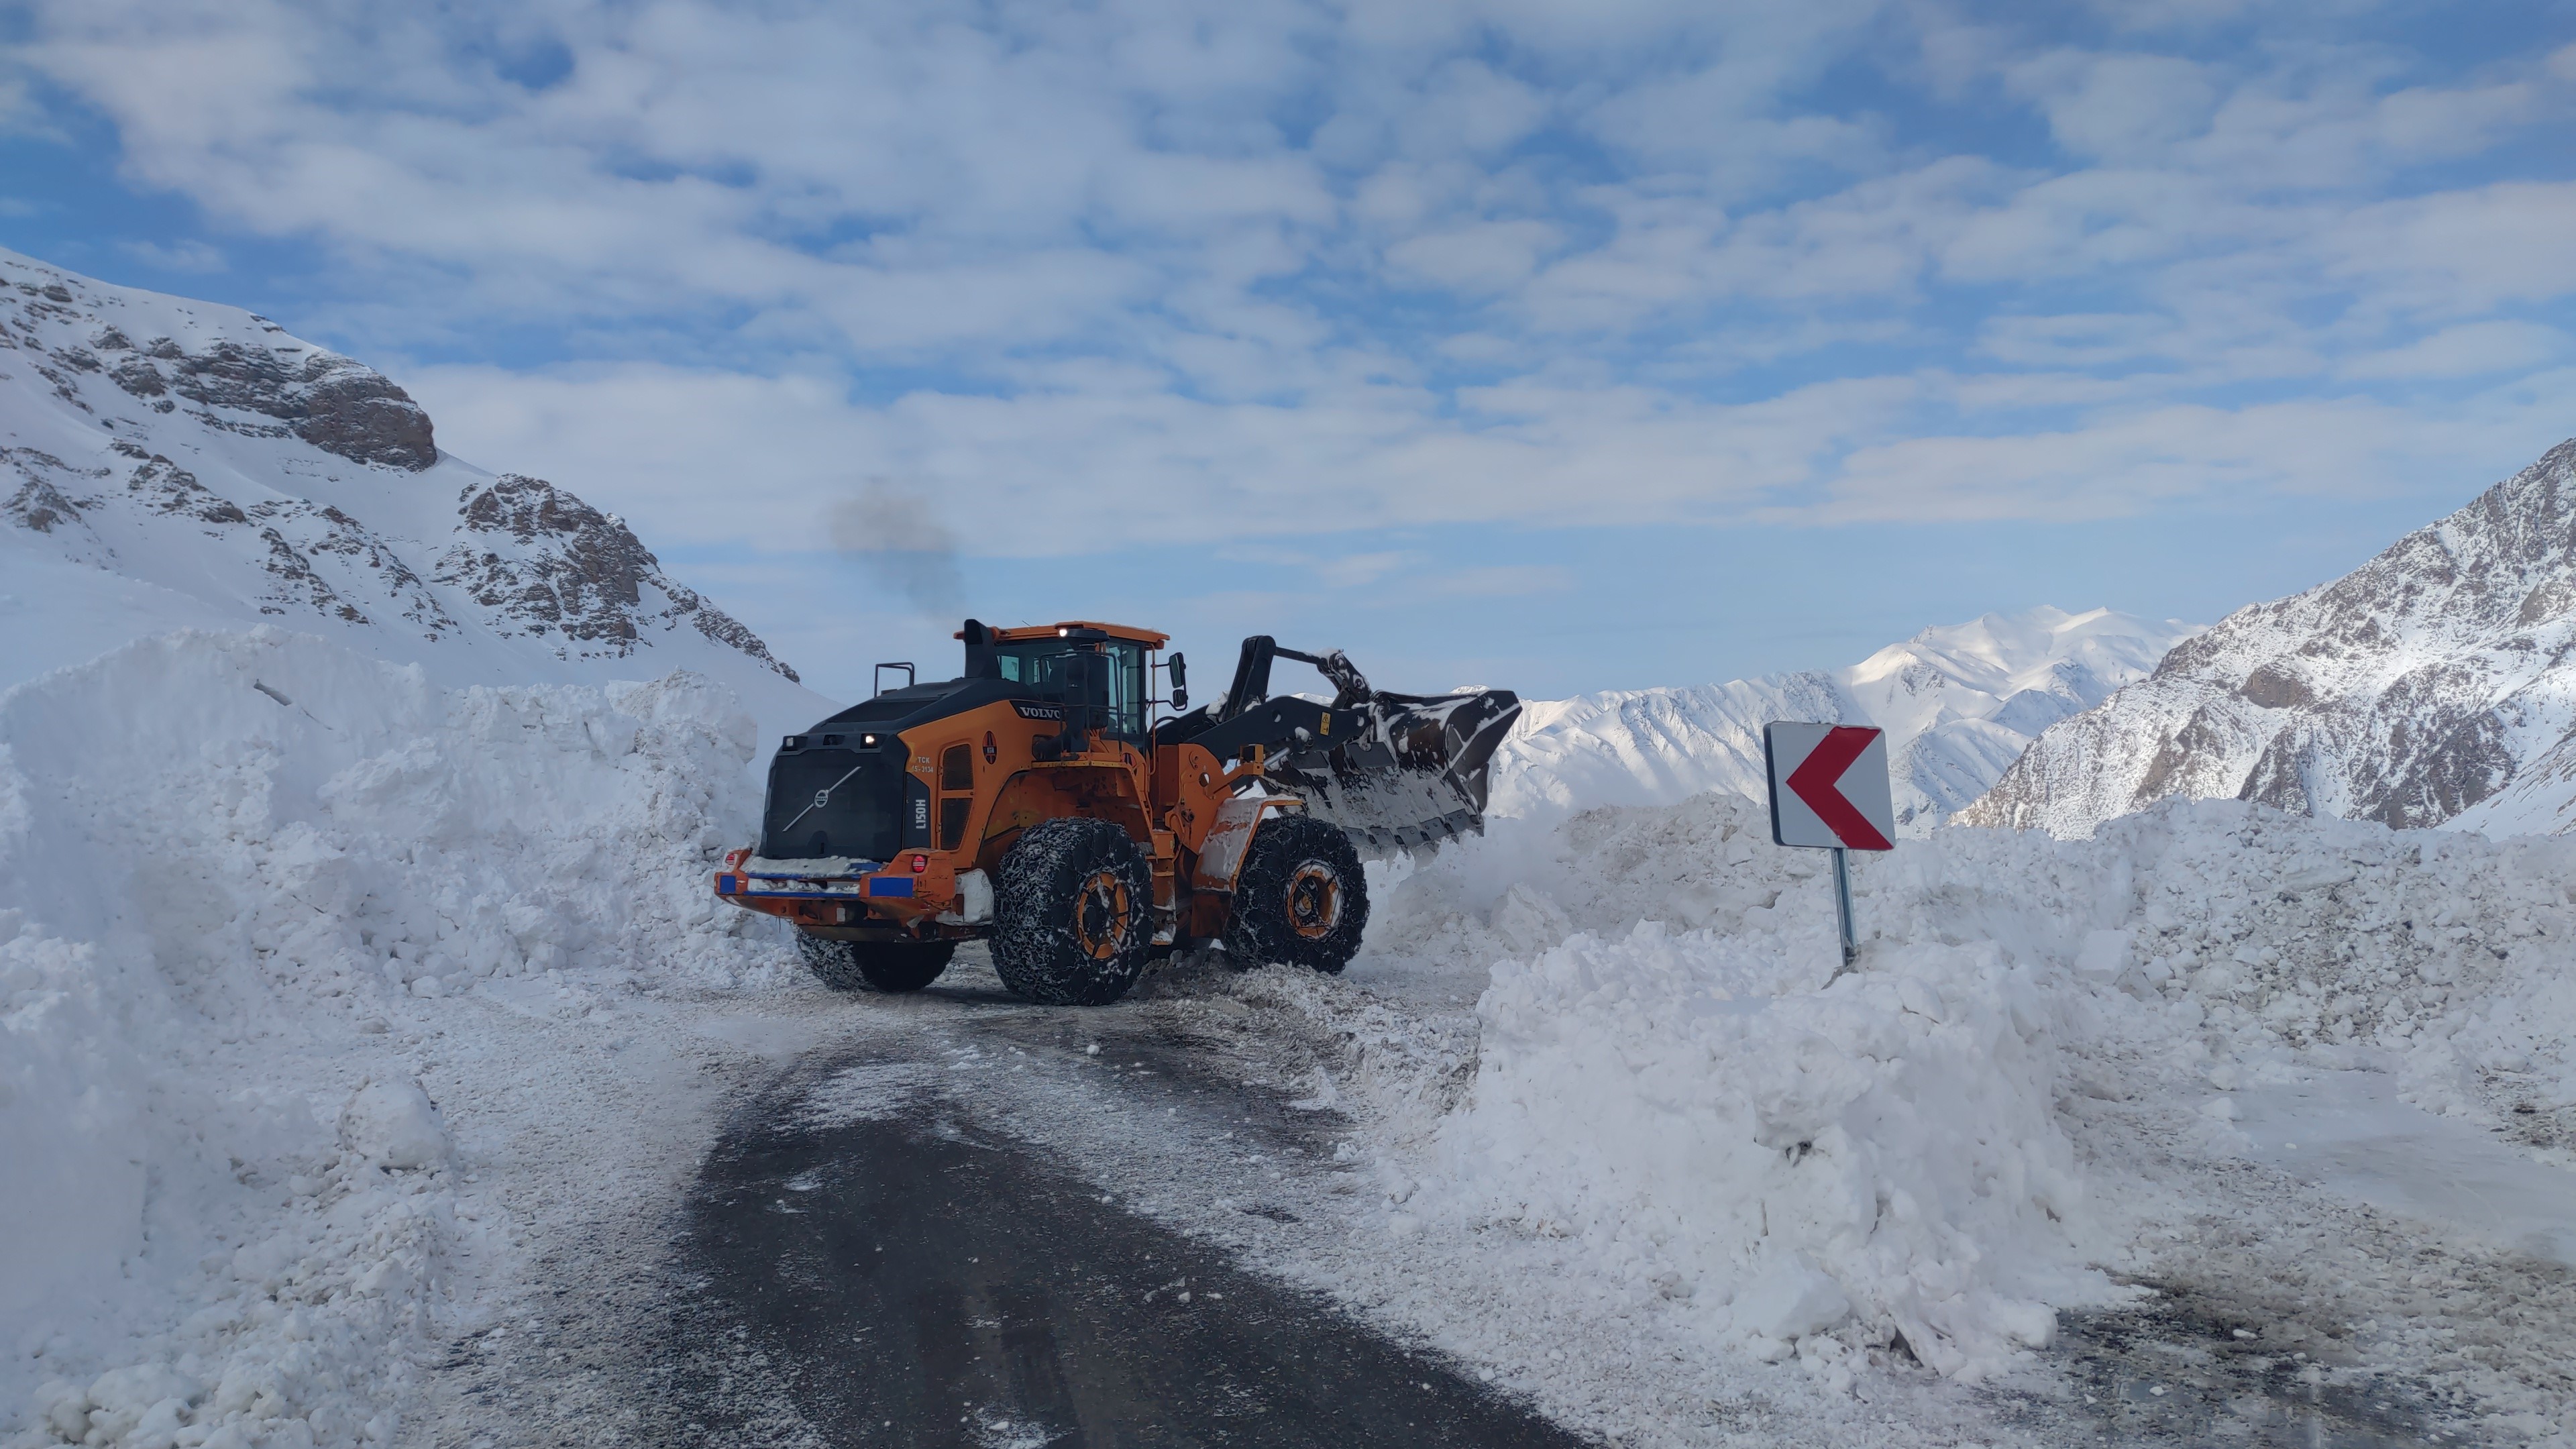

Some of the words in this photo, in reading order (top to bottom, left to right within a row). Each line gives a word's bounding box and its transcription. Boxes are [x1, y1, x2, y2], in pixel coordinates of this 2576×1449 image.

[1020, 706, 1060, 719] VOLVO
[917, 756, 930, 764] TCK
[915, 799, 926, 829] L150H
